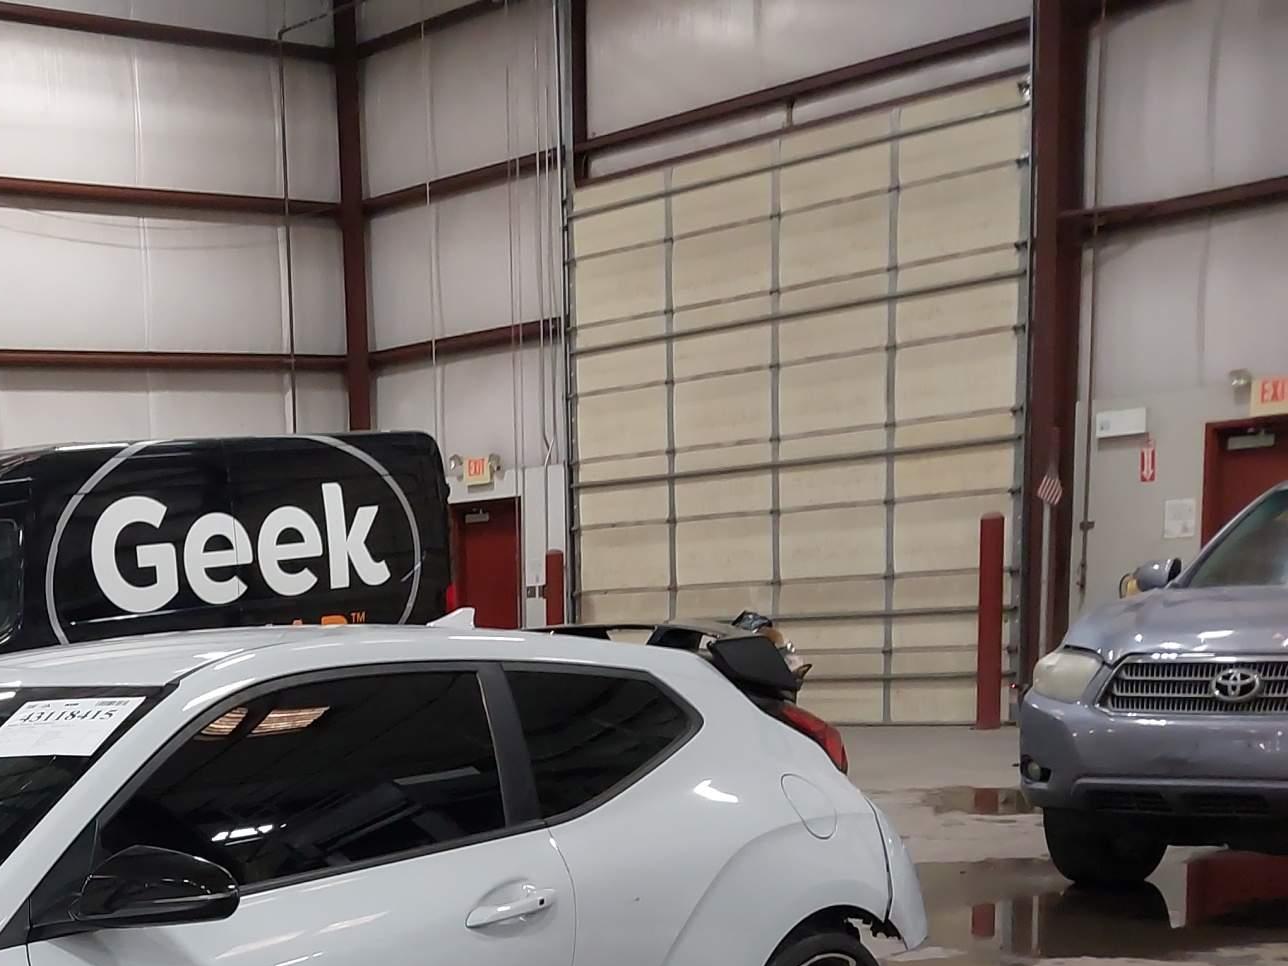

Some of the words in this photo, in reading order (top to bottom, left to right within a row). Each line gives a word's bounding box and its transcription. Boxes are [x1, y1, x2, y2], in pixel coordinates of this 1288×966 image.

[1260, 377, 1288, 403] EXI
[468, 458, 485, 476] EXIT
[91, 482, 391, 613] Geek
[20, 709, 118, 722] 43118415
